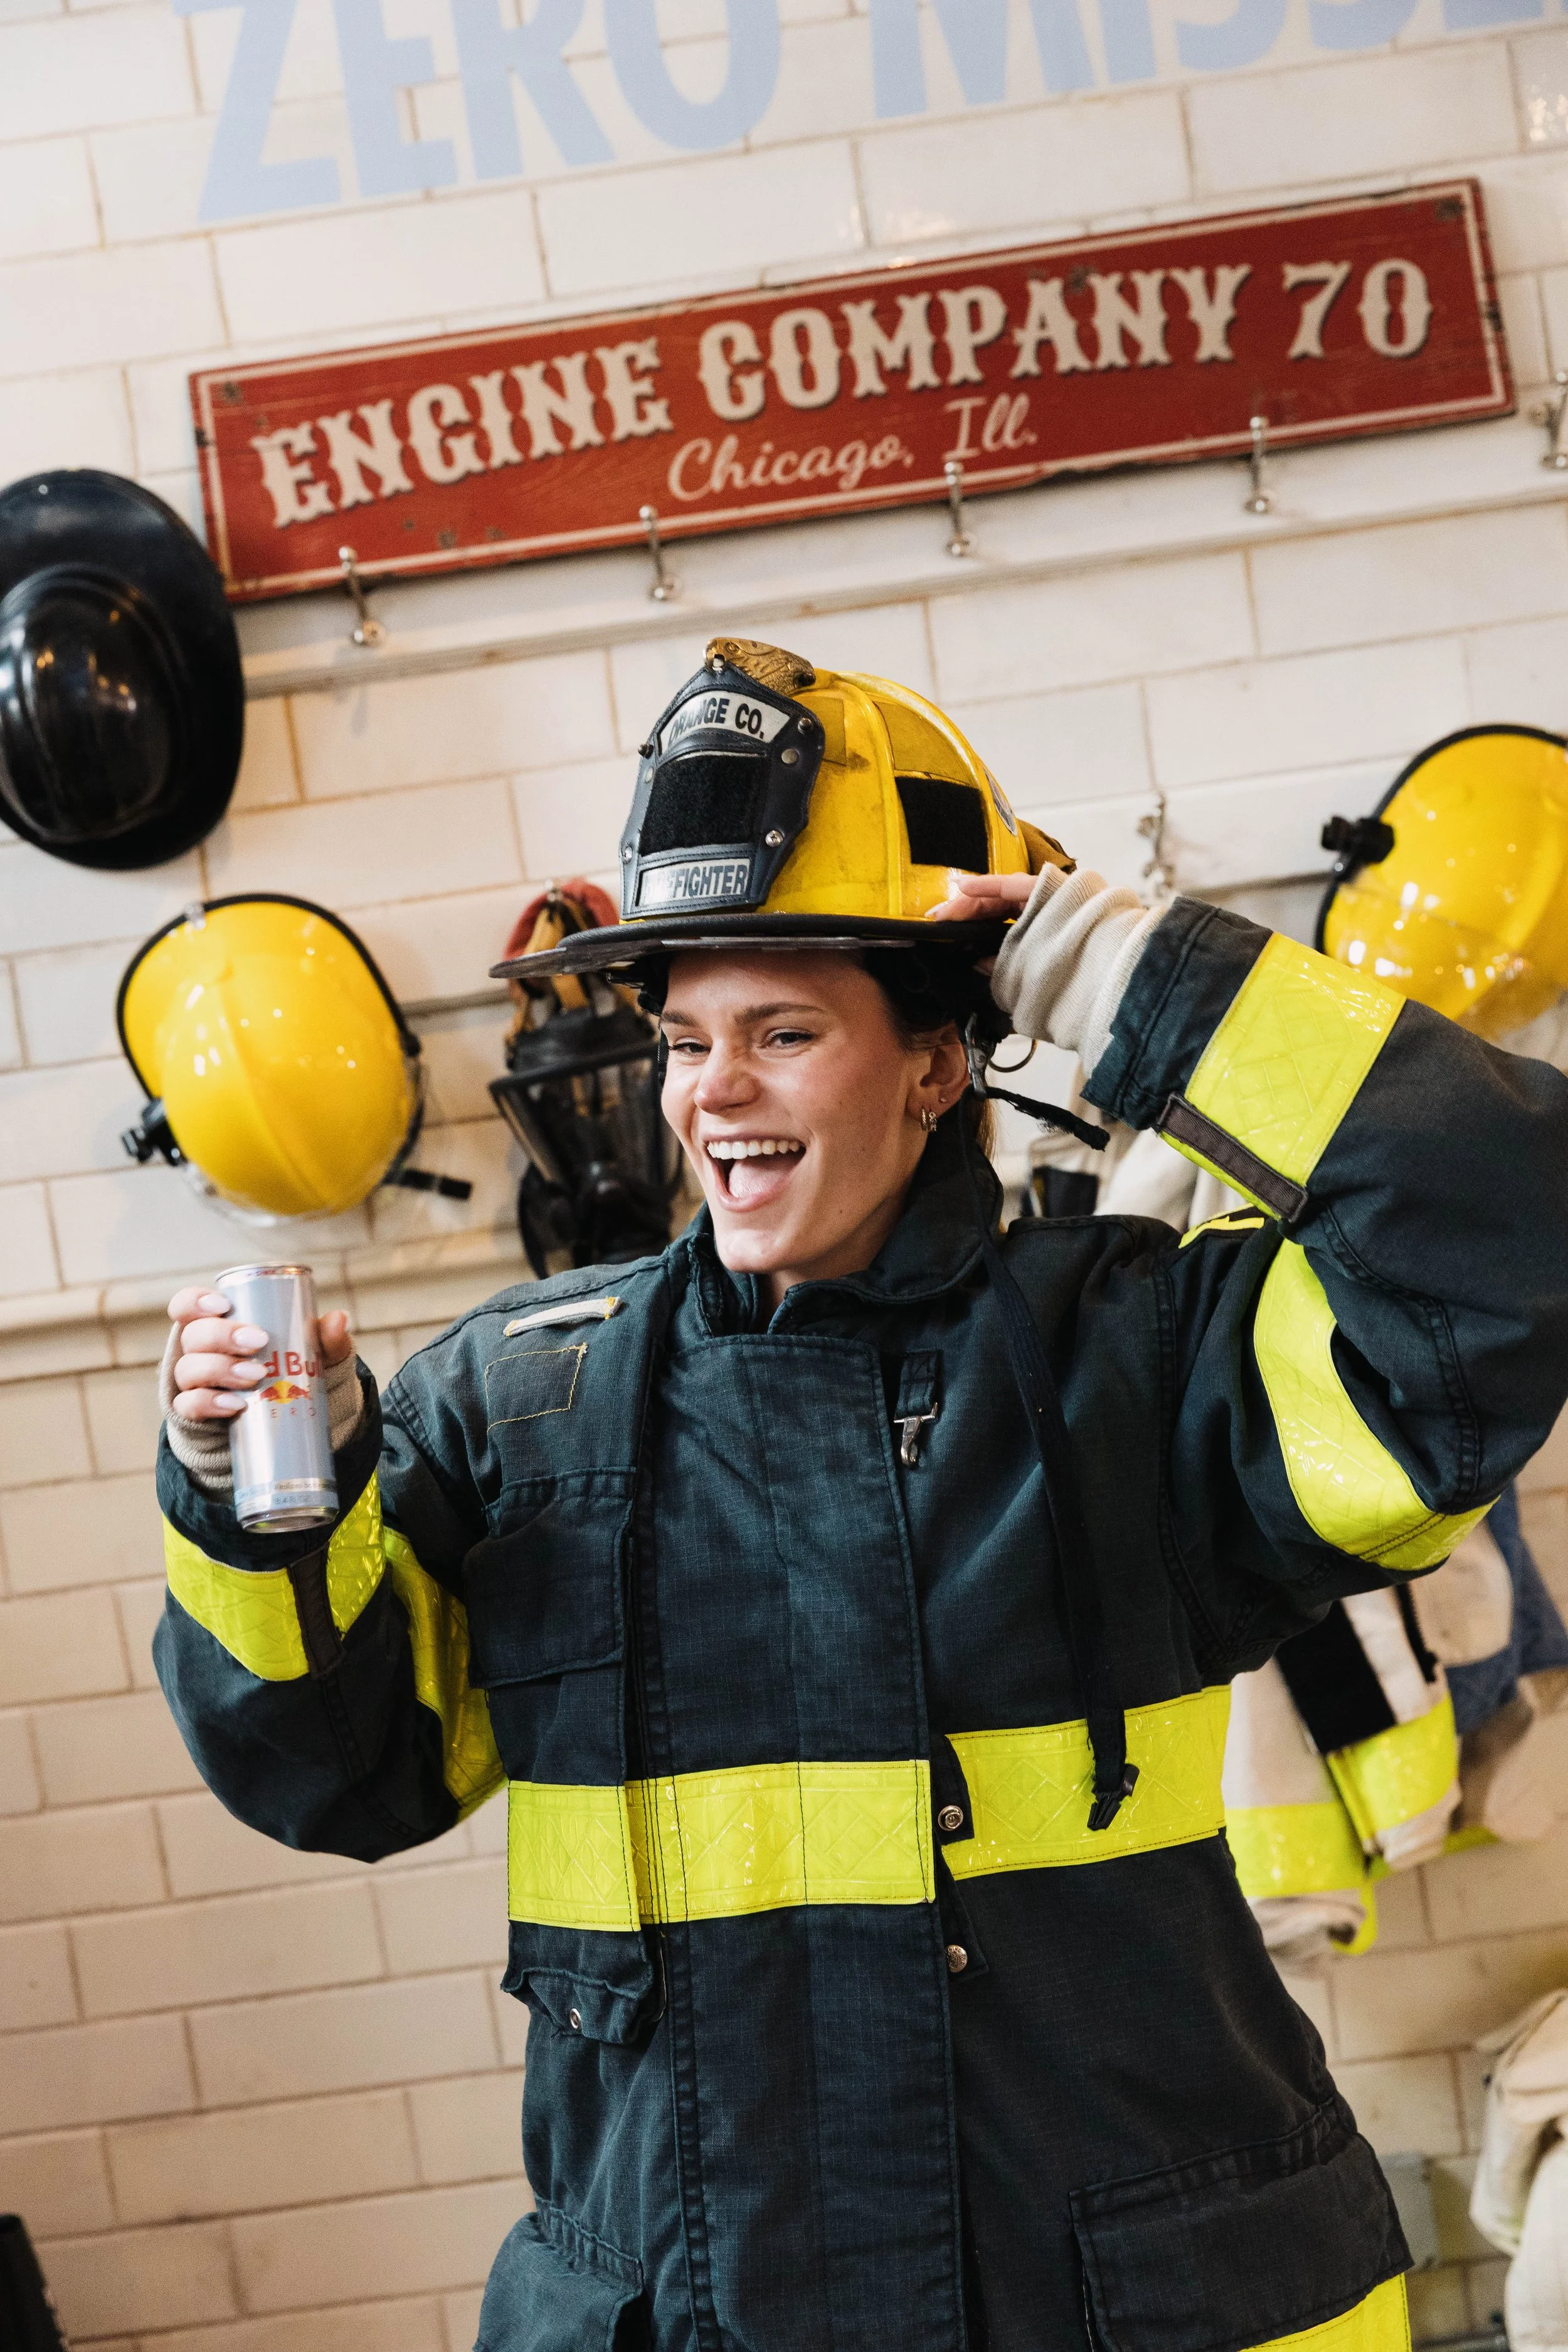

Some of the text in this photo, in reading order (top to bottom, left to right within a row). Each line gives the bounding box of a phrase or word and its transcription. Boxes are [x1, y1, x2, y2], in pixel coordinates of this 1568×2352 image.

[172, 0, 783, 221] ZERO
[251, 257, 1433, 529] ENGINE COMPANY 70
[667, 393, 1038, 501] Chicago, Ill.
[735, 702, 765, 739] CO.
[644, 864, 748, 901] FIGHTER
[284, 1351, 322, 1378] Bul
